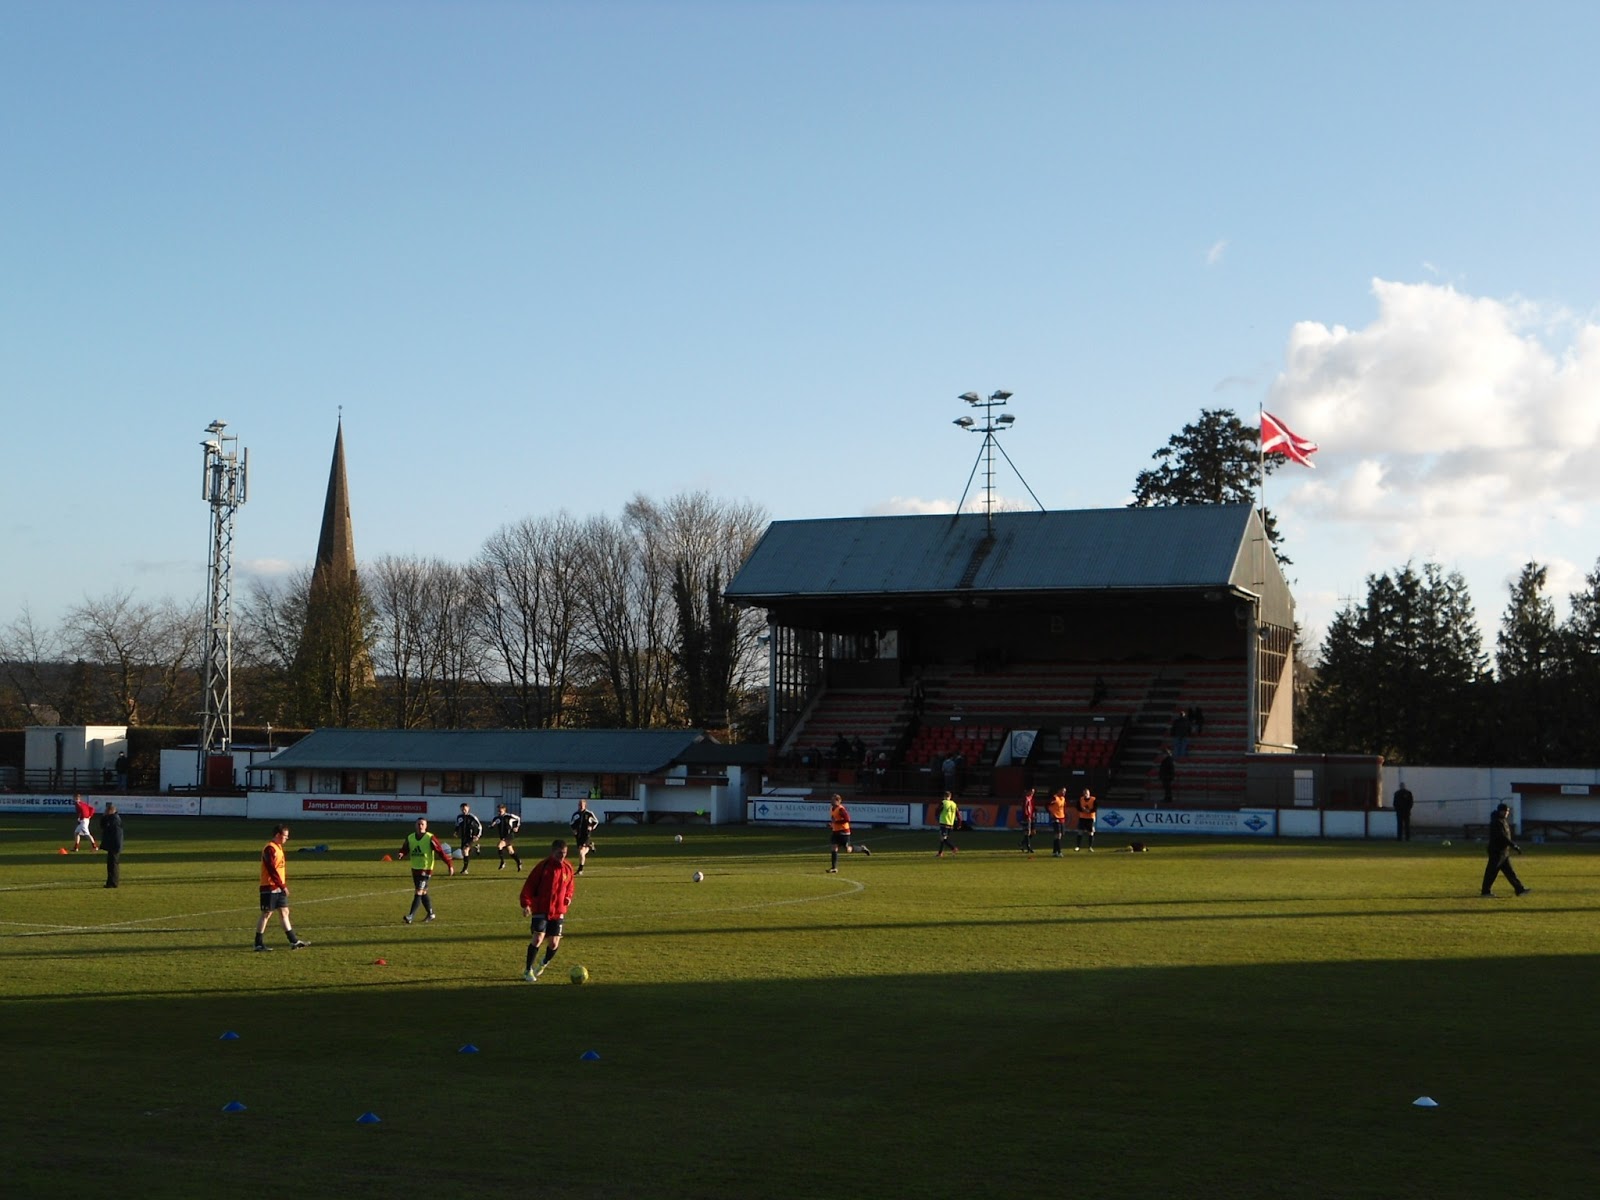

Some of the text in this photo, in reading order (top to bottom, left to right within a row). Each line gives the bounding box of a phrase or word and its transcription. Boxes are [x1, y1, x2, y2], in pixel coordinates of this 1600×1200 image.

[308, 802, 329, 810] James
[330, 802, 365, 810] Lammond
[366, 802, 379, 810] Ltd
